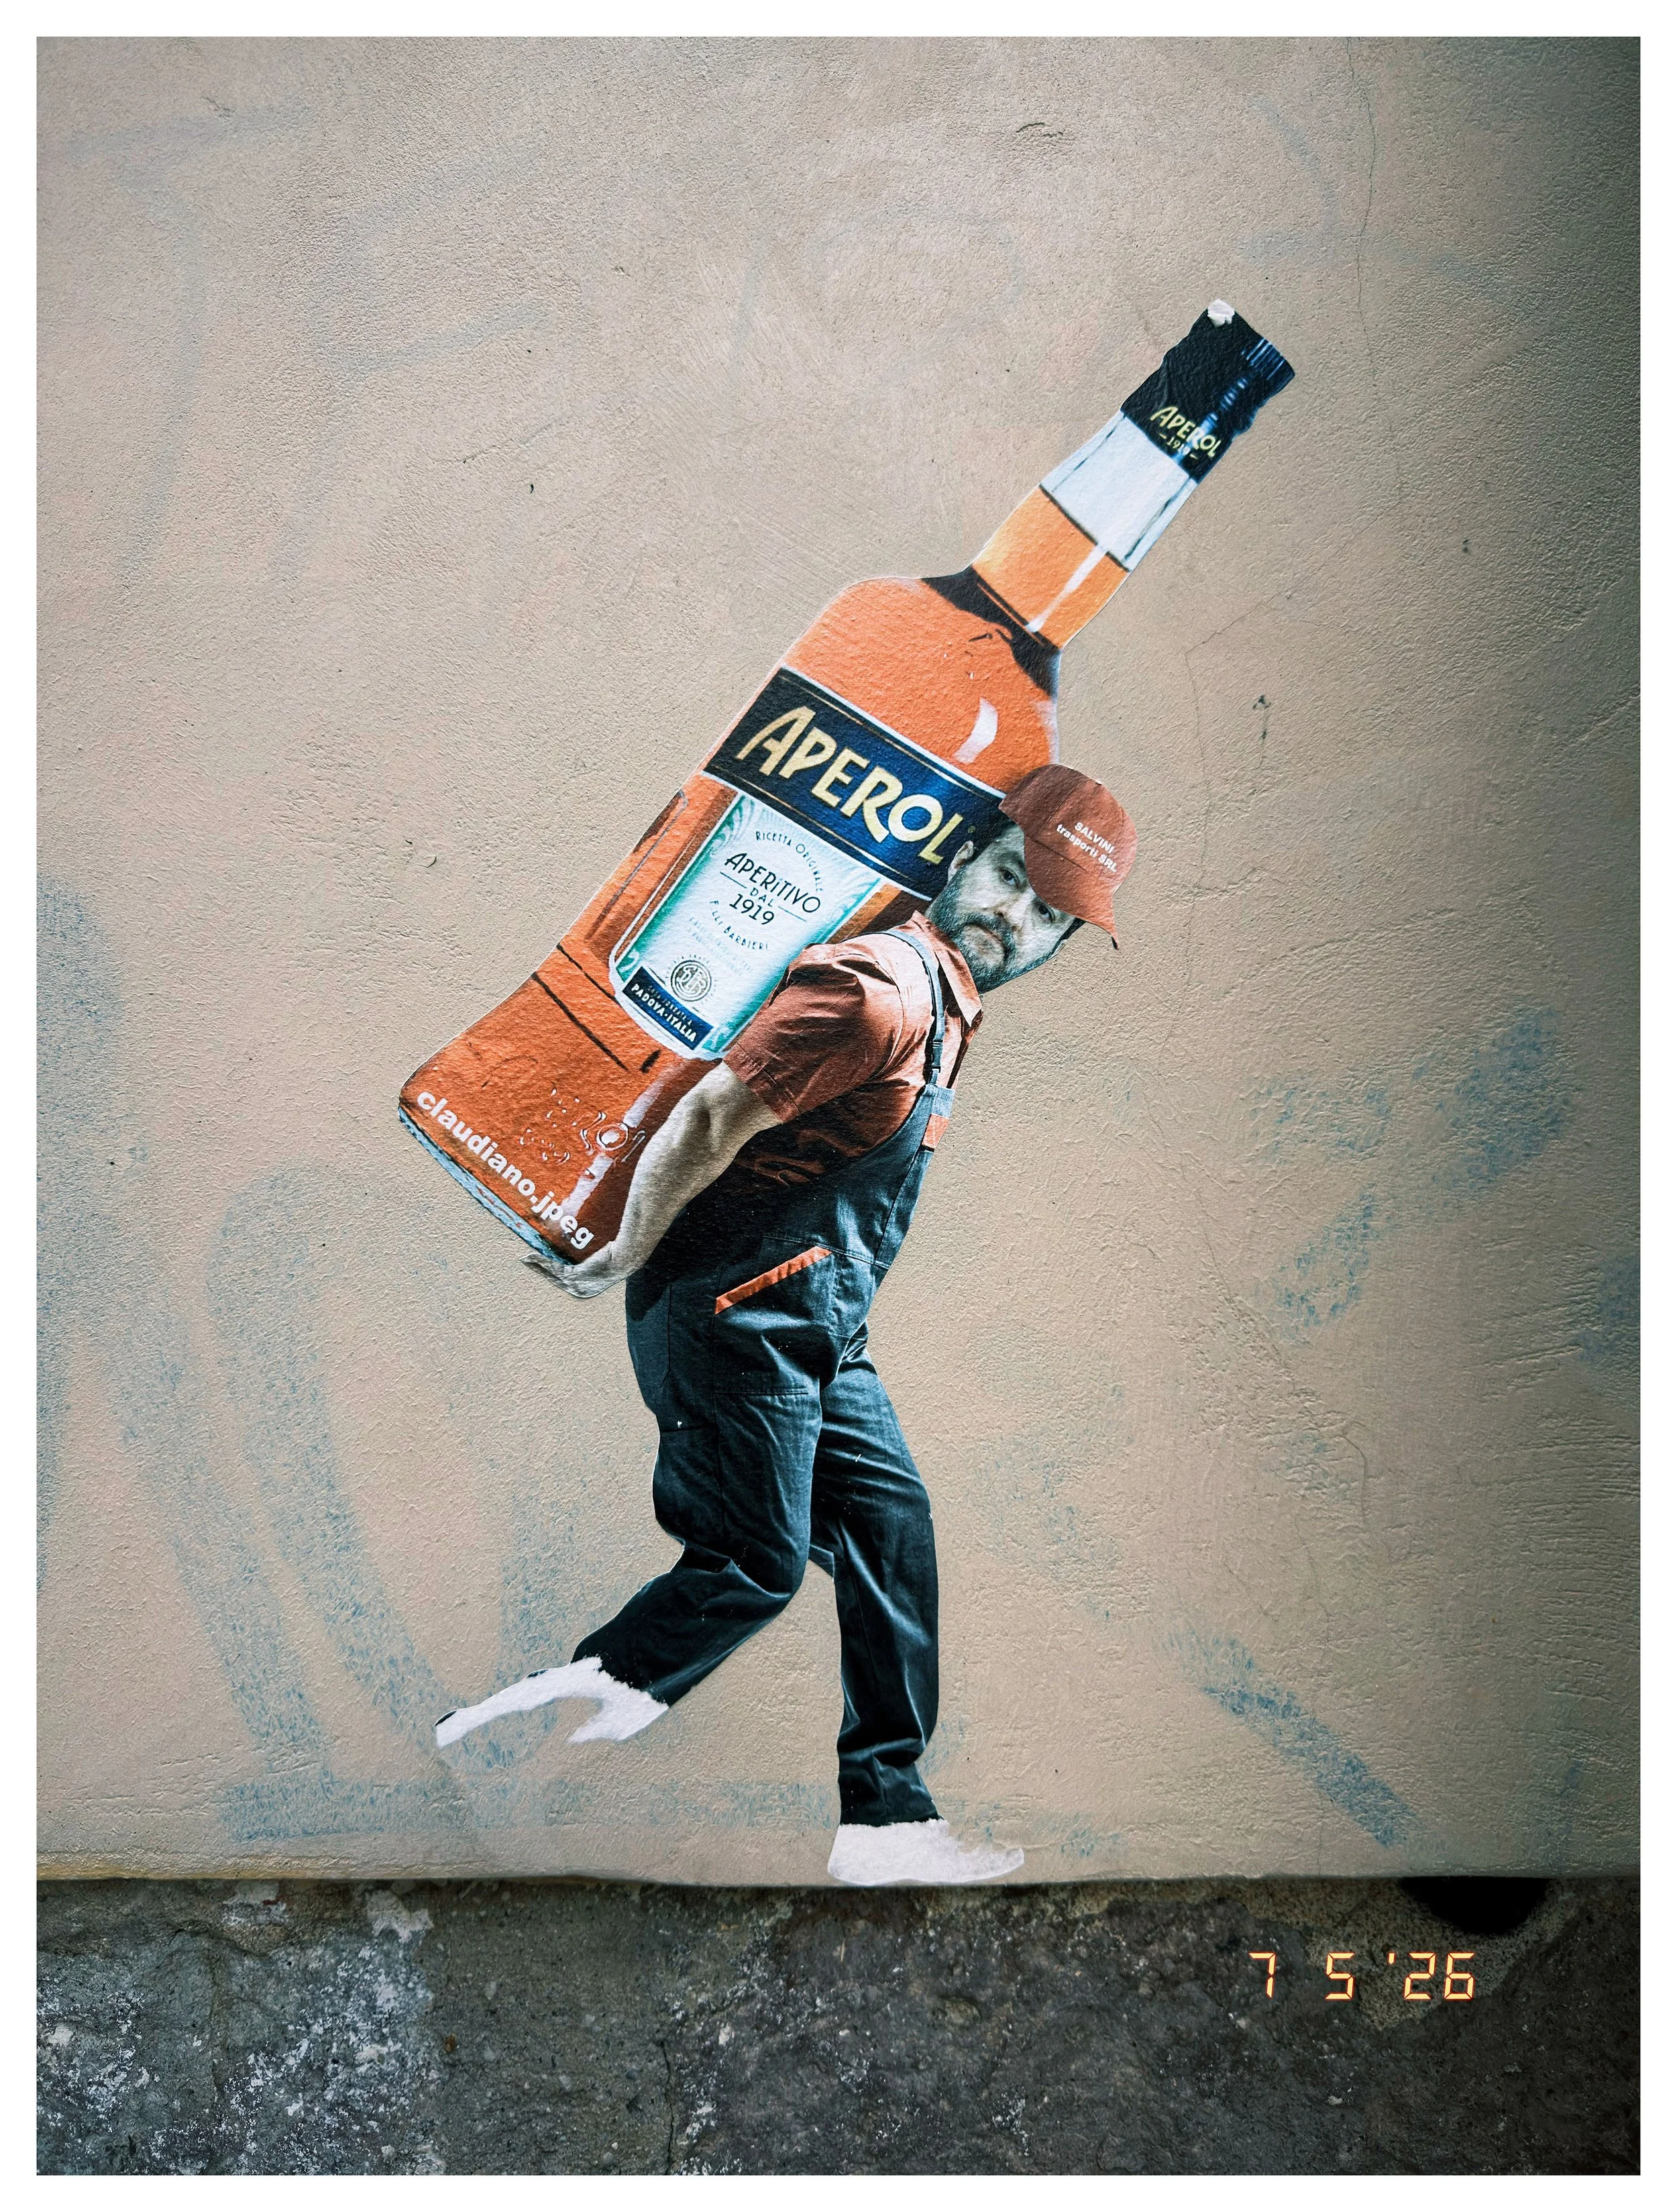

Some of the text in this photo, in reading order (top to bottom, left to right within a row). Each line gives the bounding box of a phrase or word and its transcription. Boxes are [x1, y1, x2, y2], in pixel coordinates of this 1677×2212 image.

[1150, 405, 1222, 458] APEROL
[735, 705, 964, 865] APEROL
[755, 831, 792, 847] RICETTA
[1056, 823, 1118, 873] trasporti SRL
[1074, 822, 1116, 854] SALVINI
[728, 893, 775, 925] 1919
[749, 887, 773, 907] DAL
[724, 925, 768, 950] BARBIERI
[417, 1092, 595, 1250] claudiano.jpeg
